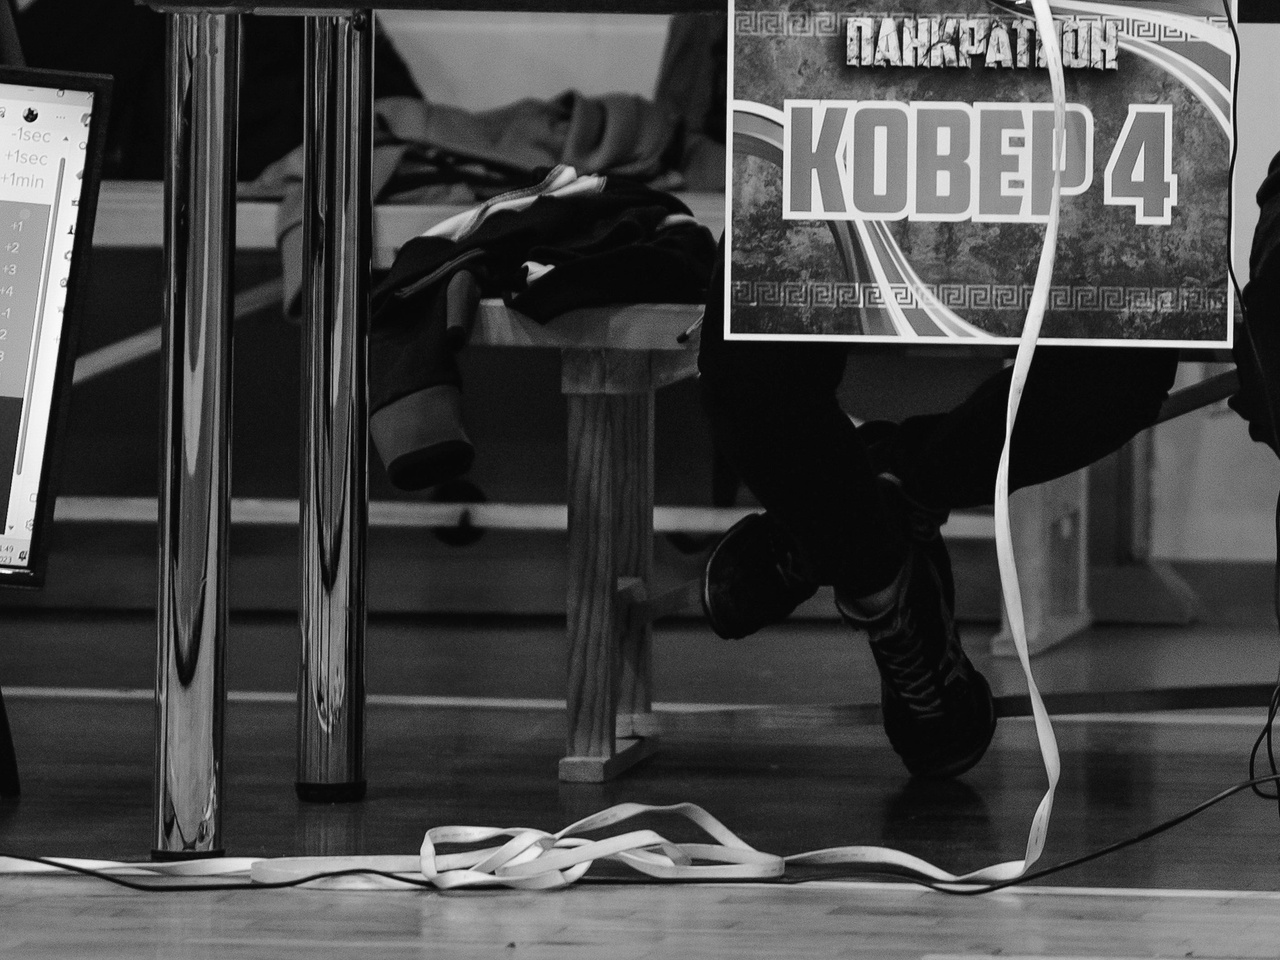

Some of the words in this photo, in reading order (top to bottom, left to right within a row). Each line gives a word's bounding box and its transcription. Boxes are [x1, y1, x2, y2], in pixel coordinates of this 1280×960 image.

[11, 126, 51, 143] -1sec
[5, 149, 48, 166] +1sec
[783, 99, 1094, 223] КОВЕР
[1103, 104, 1177, 225] 4
[1, 172, 44, 189] +1min
